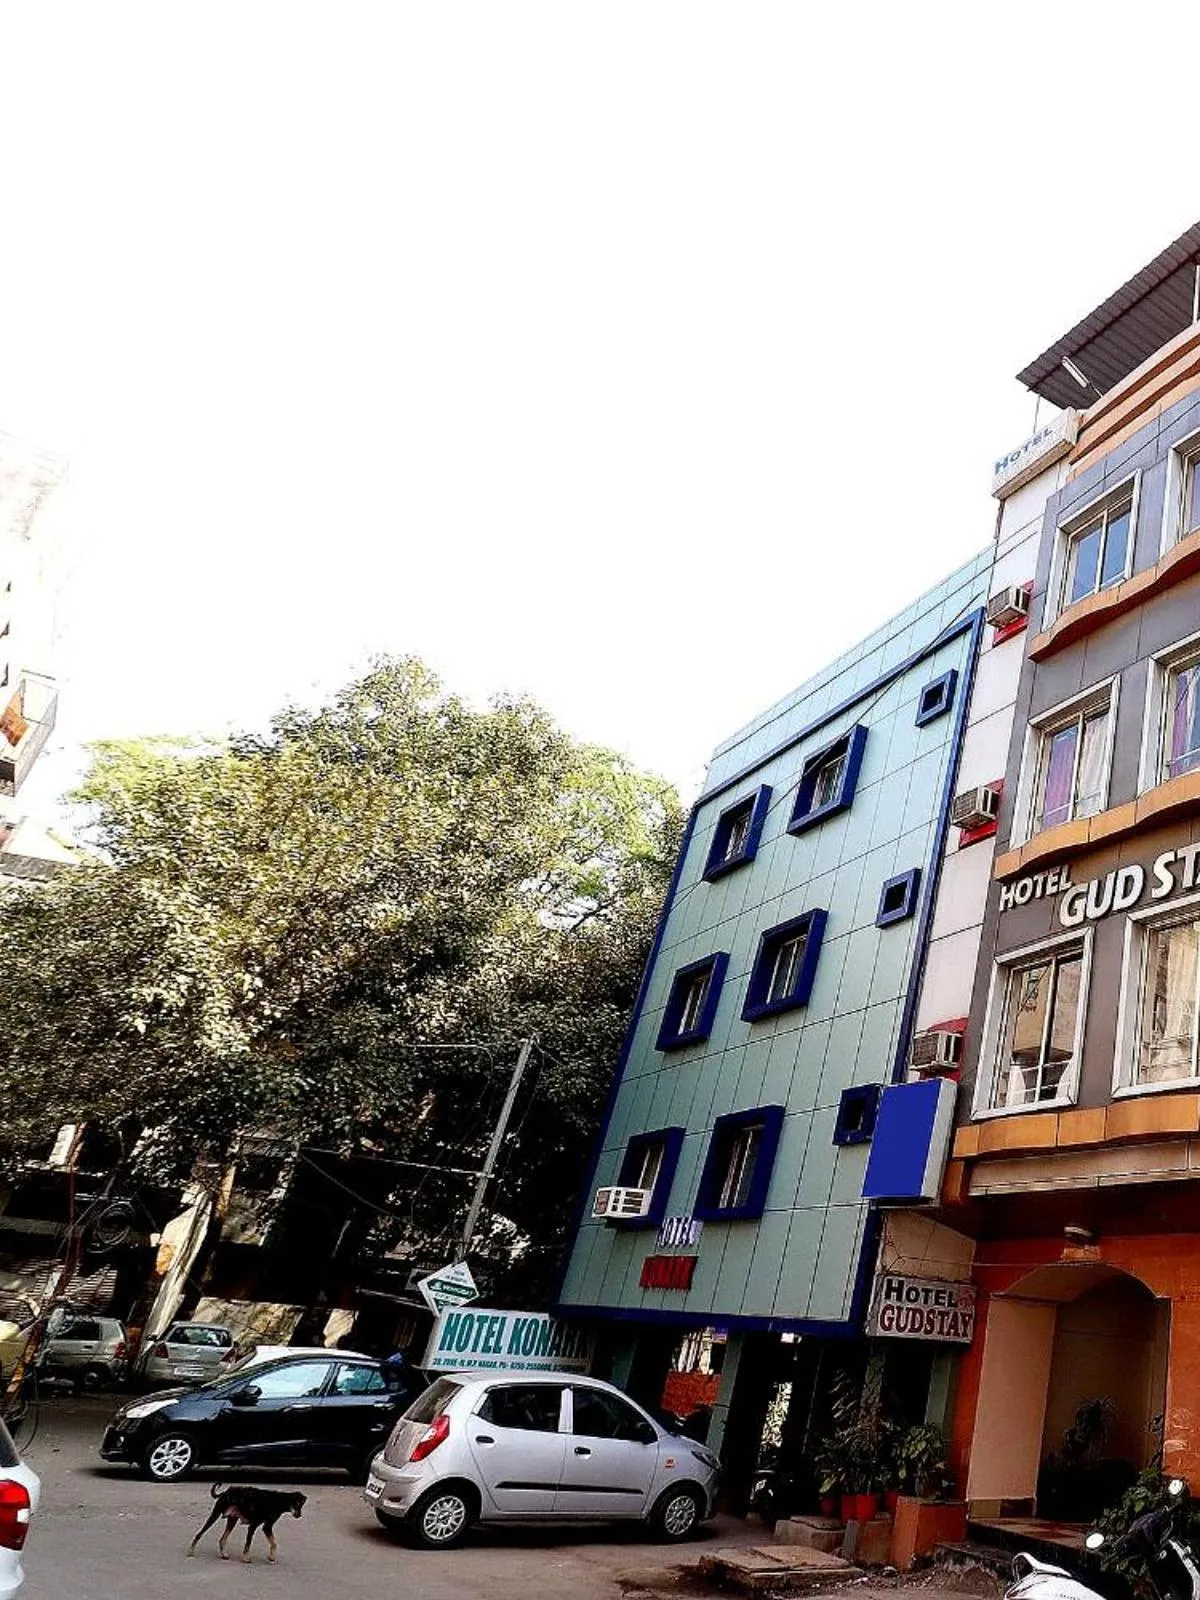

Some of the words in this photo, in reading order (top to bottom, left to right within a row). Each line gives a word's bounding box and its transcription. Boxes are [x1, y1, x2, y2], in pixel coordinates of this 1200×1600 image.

[994, 427, 1053, 474] HOTEL
[999, 864, 1074, 912] HOTEL
[1059, 864, 1145, 927] GUD
[885, 1279, 957, 1307] HOTEL
[439, 1312, 507, 1355] HOTEL
[880, 1303, 974, 1337] GUDSTAY
